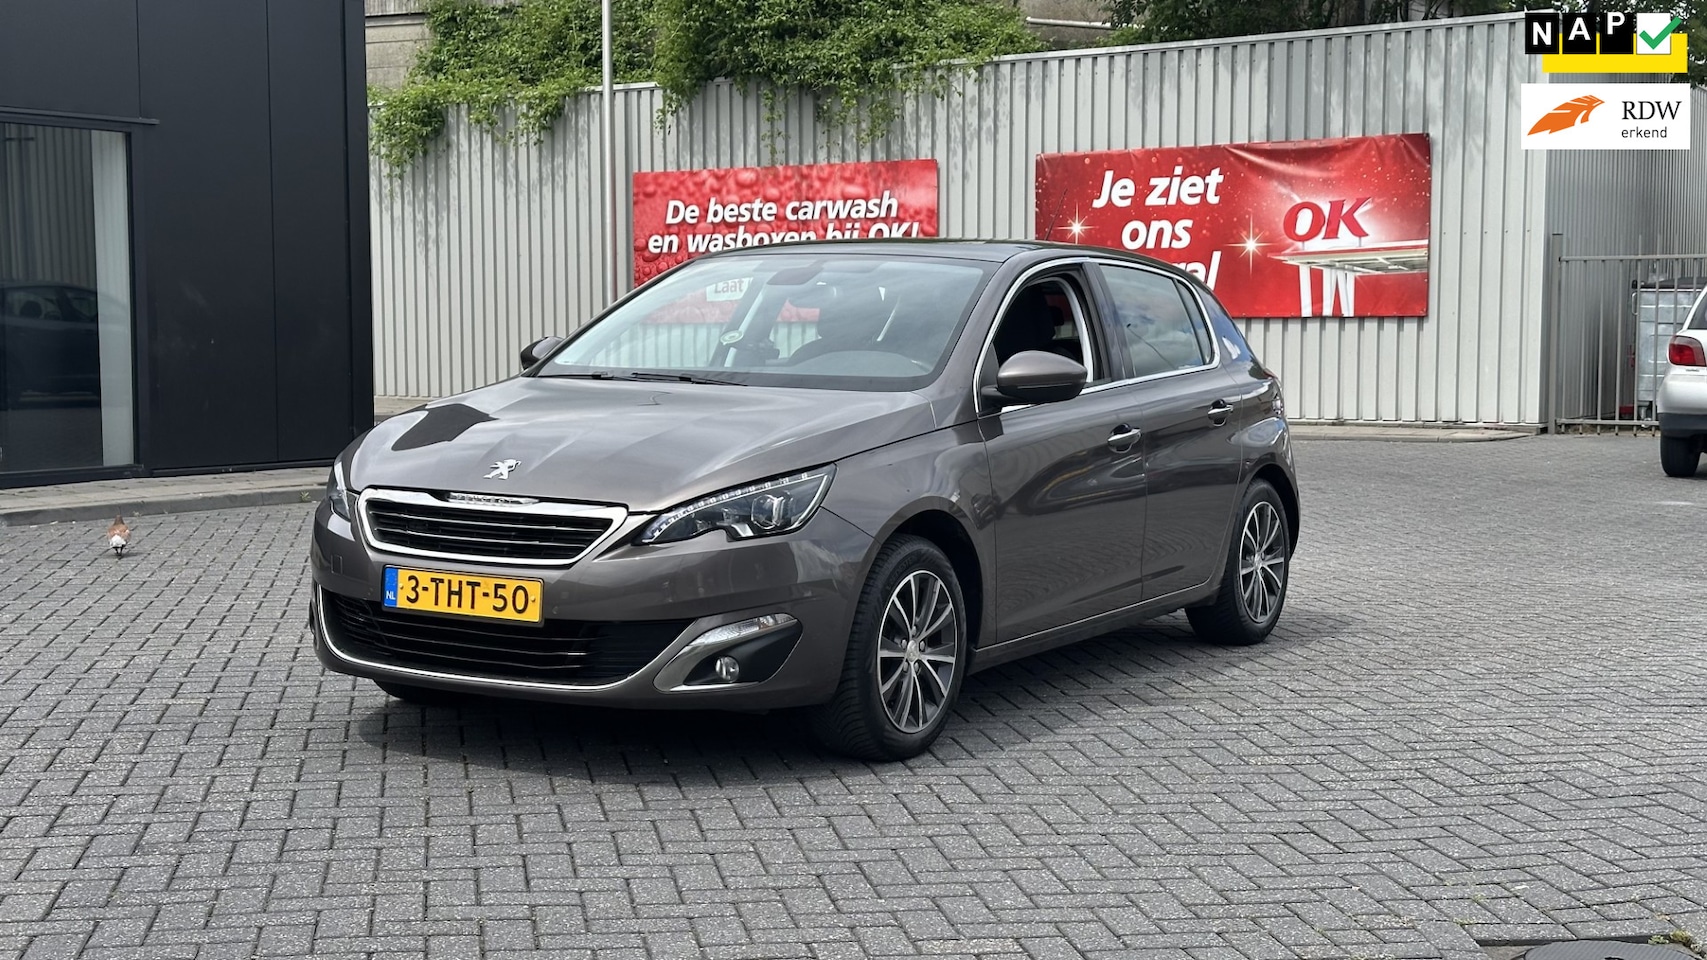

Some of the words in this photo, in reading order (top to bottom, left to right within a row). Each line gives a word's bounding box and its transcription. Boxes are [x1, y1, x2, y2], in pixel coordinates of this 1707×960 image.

[1091, 169, 1136, 209] Je
[1144, 165, 1225, 207] ziet
[665, 199, 700, 225] De
[706, 196, 778, 224] beste
[785, 190, 899, 221] carwash
[1283, 196, 1372, 243] OK
[647, 233, 680, 254] en
[1121, 219, 1194, 250] ons
[713, 279, 745, 294] Laat
[385, 590, 397, 601] NL
[406, 574, 530, 615] 3-THT-50
